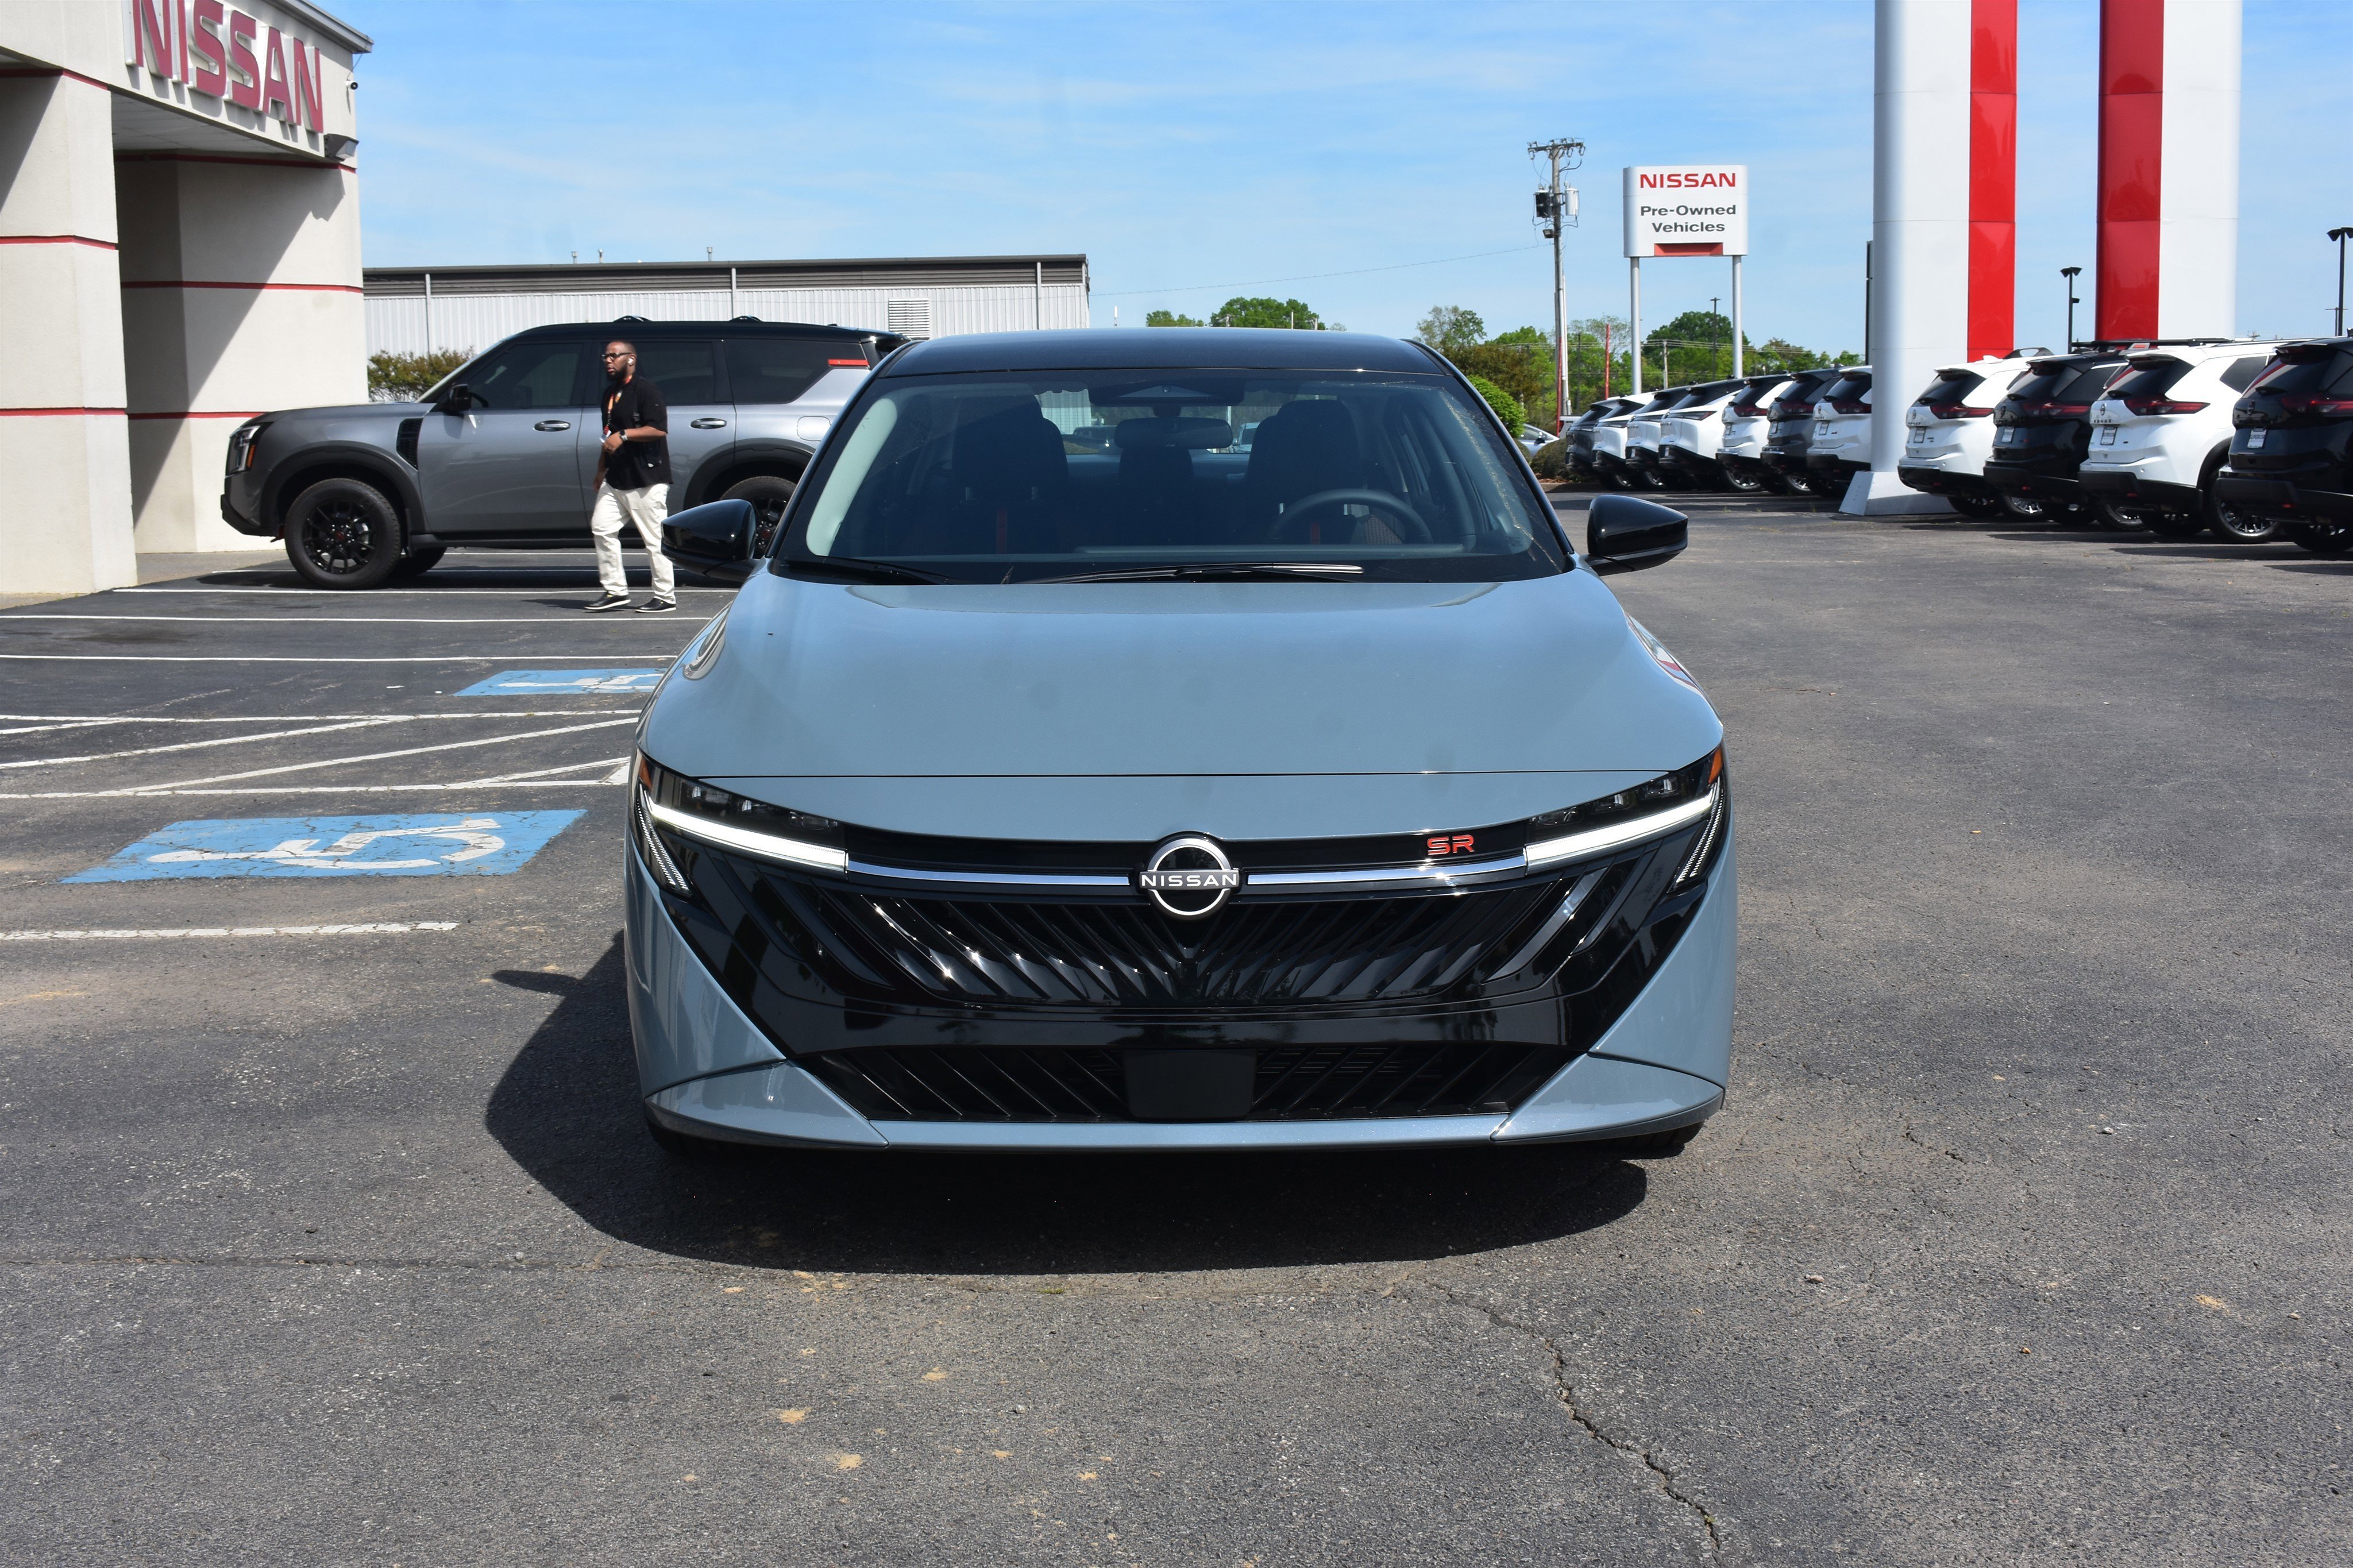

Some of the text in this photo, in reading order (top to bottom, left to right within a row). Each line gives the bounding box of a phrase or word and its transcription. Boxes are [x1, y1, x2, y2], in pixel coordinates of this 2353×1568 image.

[131, 0, 324, 134] NISSAN
[1640, 173, 1735, 188] NISSAN
[1641, 204, 1736, 216] Pre-Owned
[1652, 222, 1725, 233] Vehicles
[1427, 835, 1475, 855] SR
[1141, 874, 1237, 887] NISSAN
